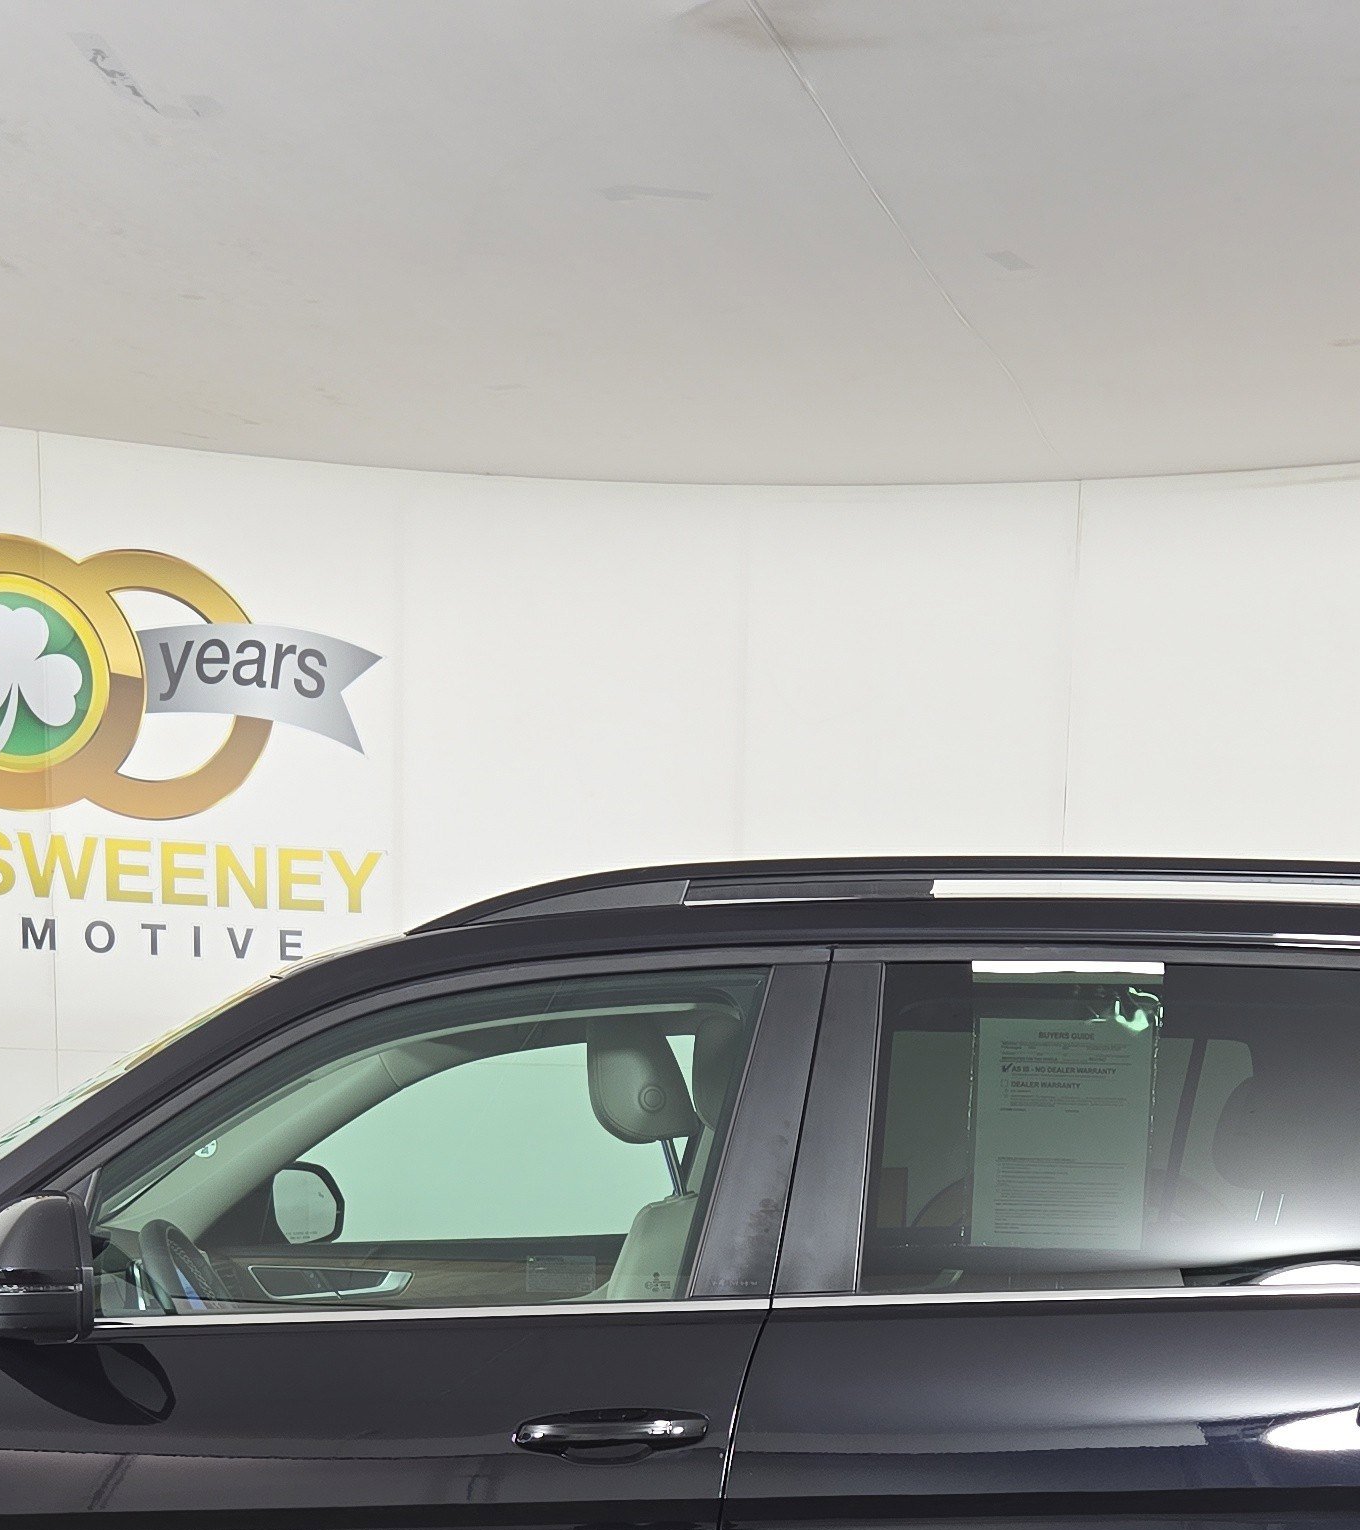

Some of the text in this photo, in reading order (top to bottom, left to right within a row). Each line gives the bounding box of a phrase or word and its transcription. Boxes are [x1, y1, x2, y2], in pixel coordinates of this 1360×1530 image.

[159, 638, 328, 700] years
[1038, 1031, 1095, 1040] BUYERS GUIDE
[1035, 1065, 1045, 1074] NO
[1047, 1066, 1076, 1074] DEALER
[1076, 1067, 1117, 1075] WARRANTY
[1011, 1081, 1081, 1090] DEALER WARRANTY
